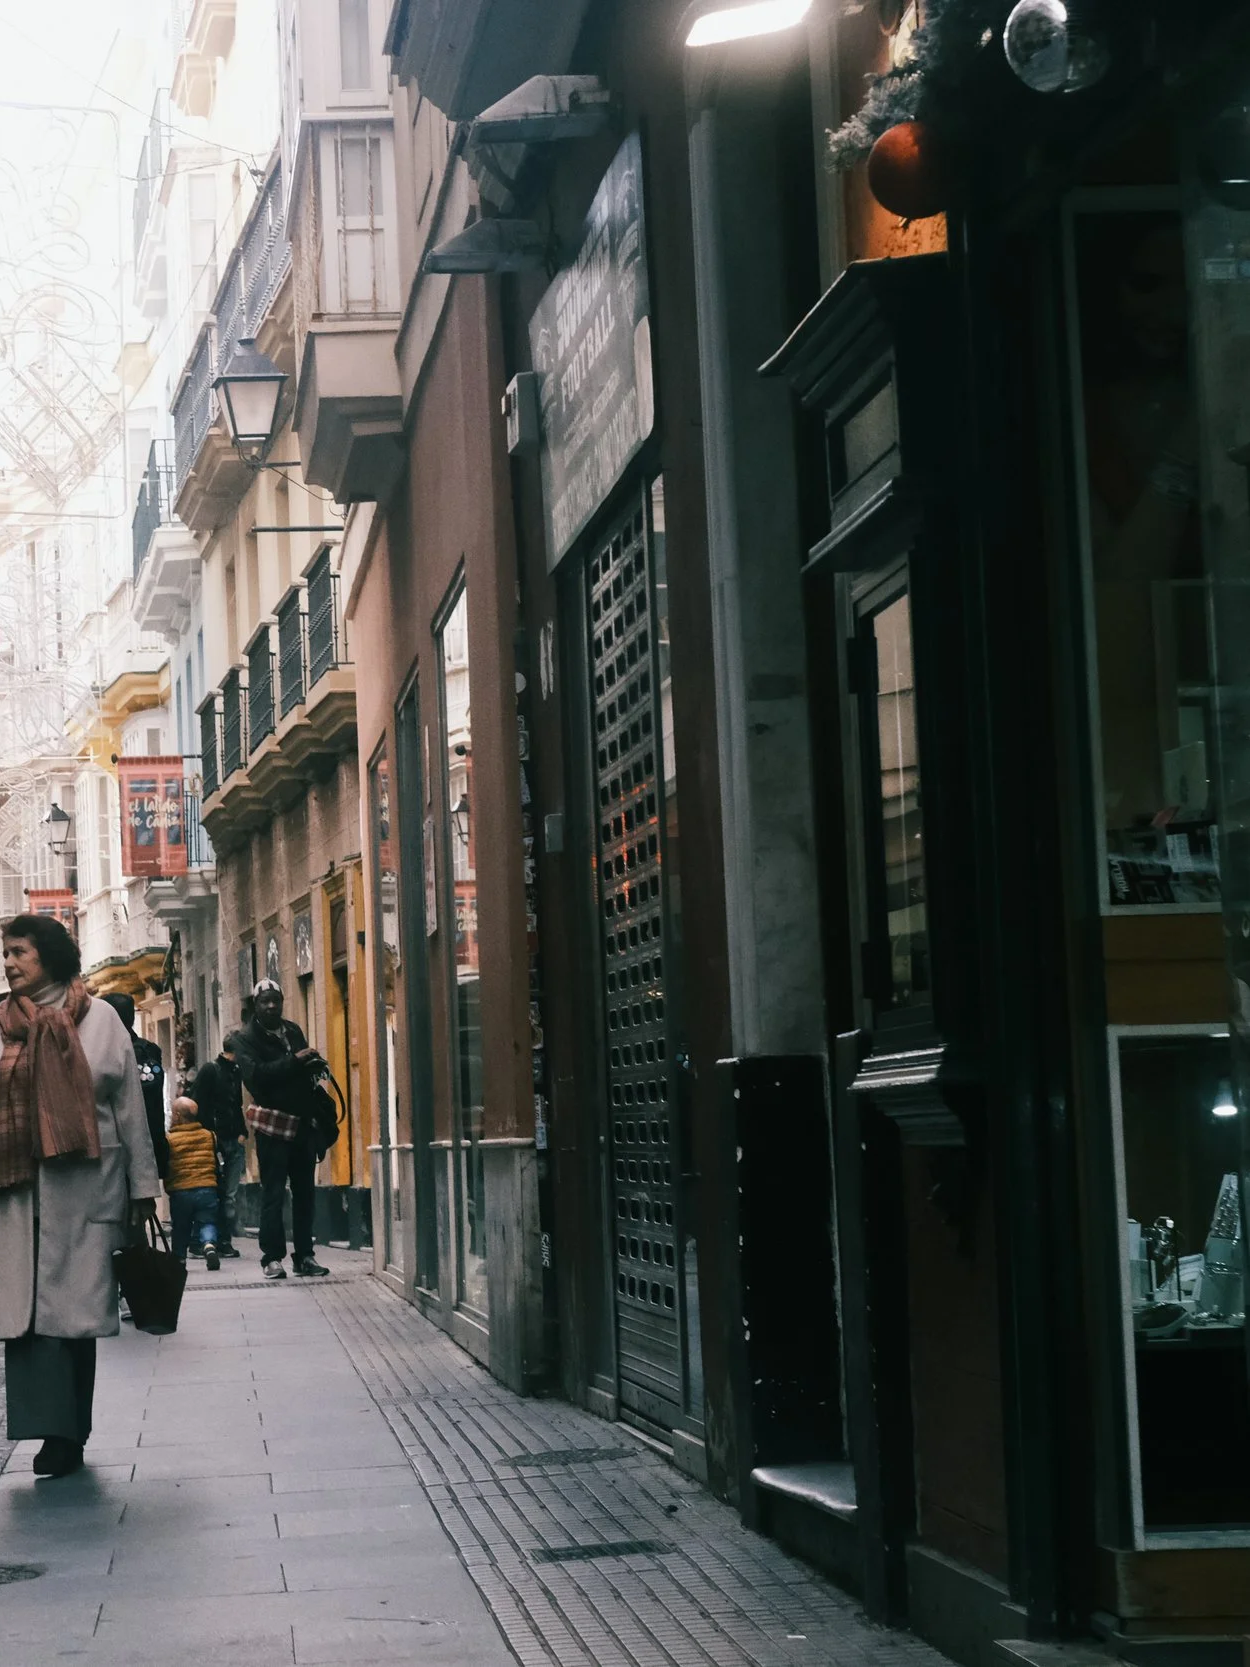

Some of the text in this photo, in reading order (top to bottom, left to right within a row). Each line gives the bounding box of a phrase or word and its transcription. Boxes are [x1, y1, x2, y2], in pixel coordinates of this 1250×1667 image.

[560, 291, 617, 413] FOOTBALL
[144, 794, 179, 813] latido
[126, 813, 180, 829] de Cádiz
